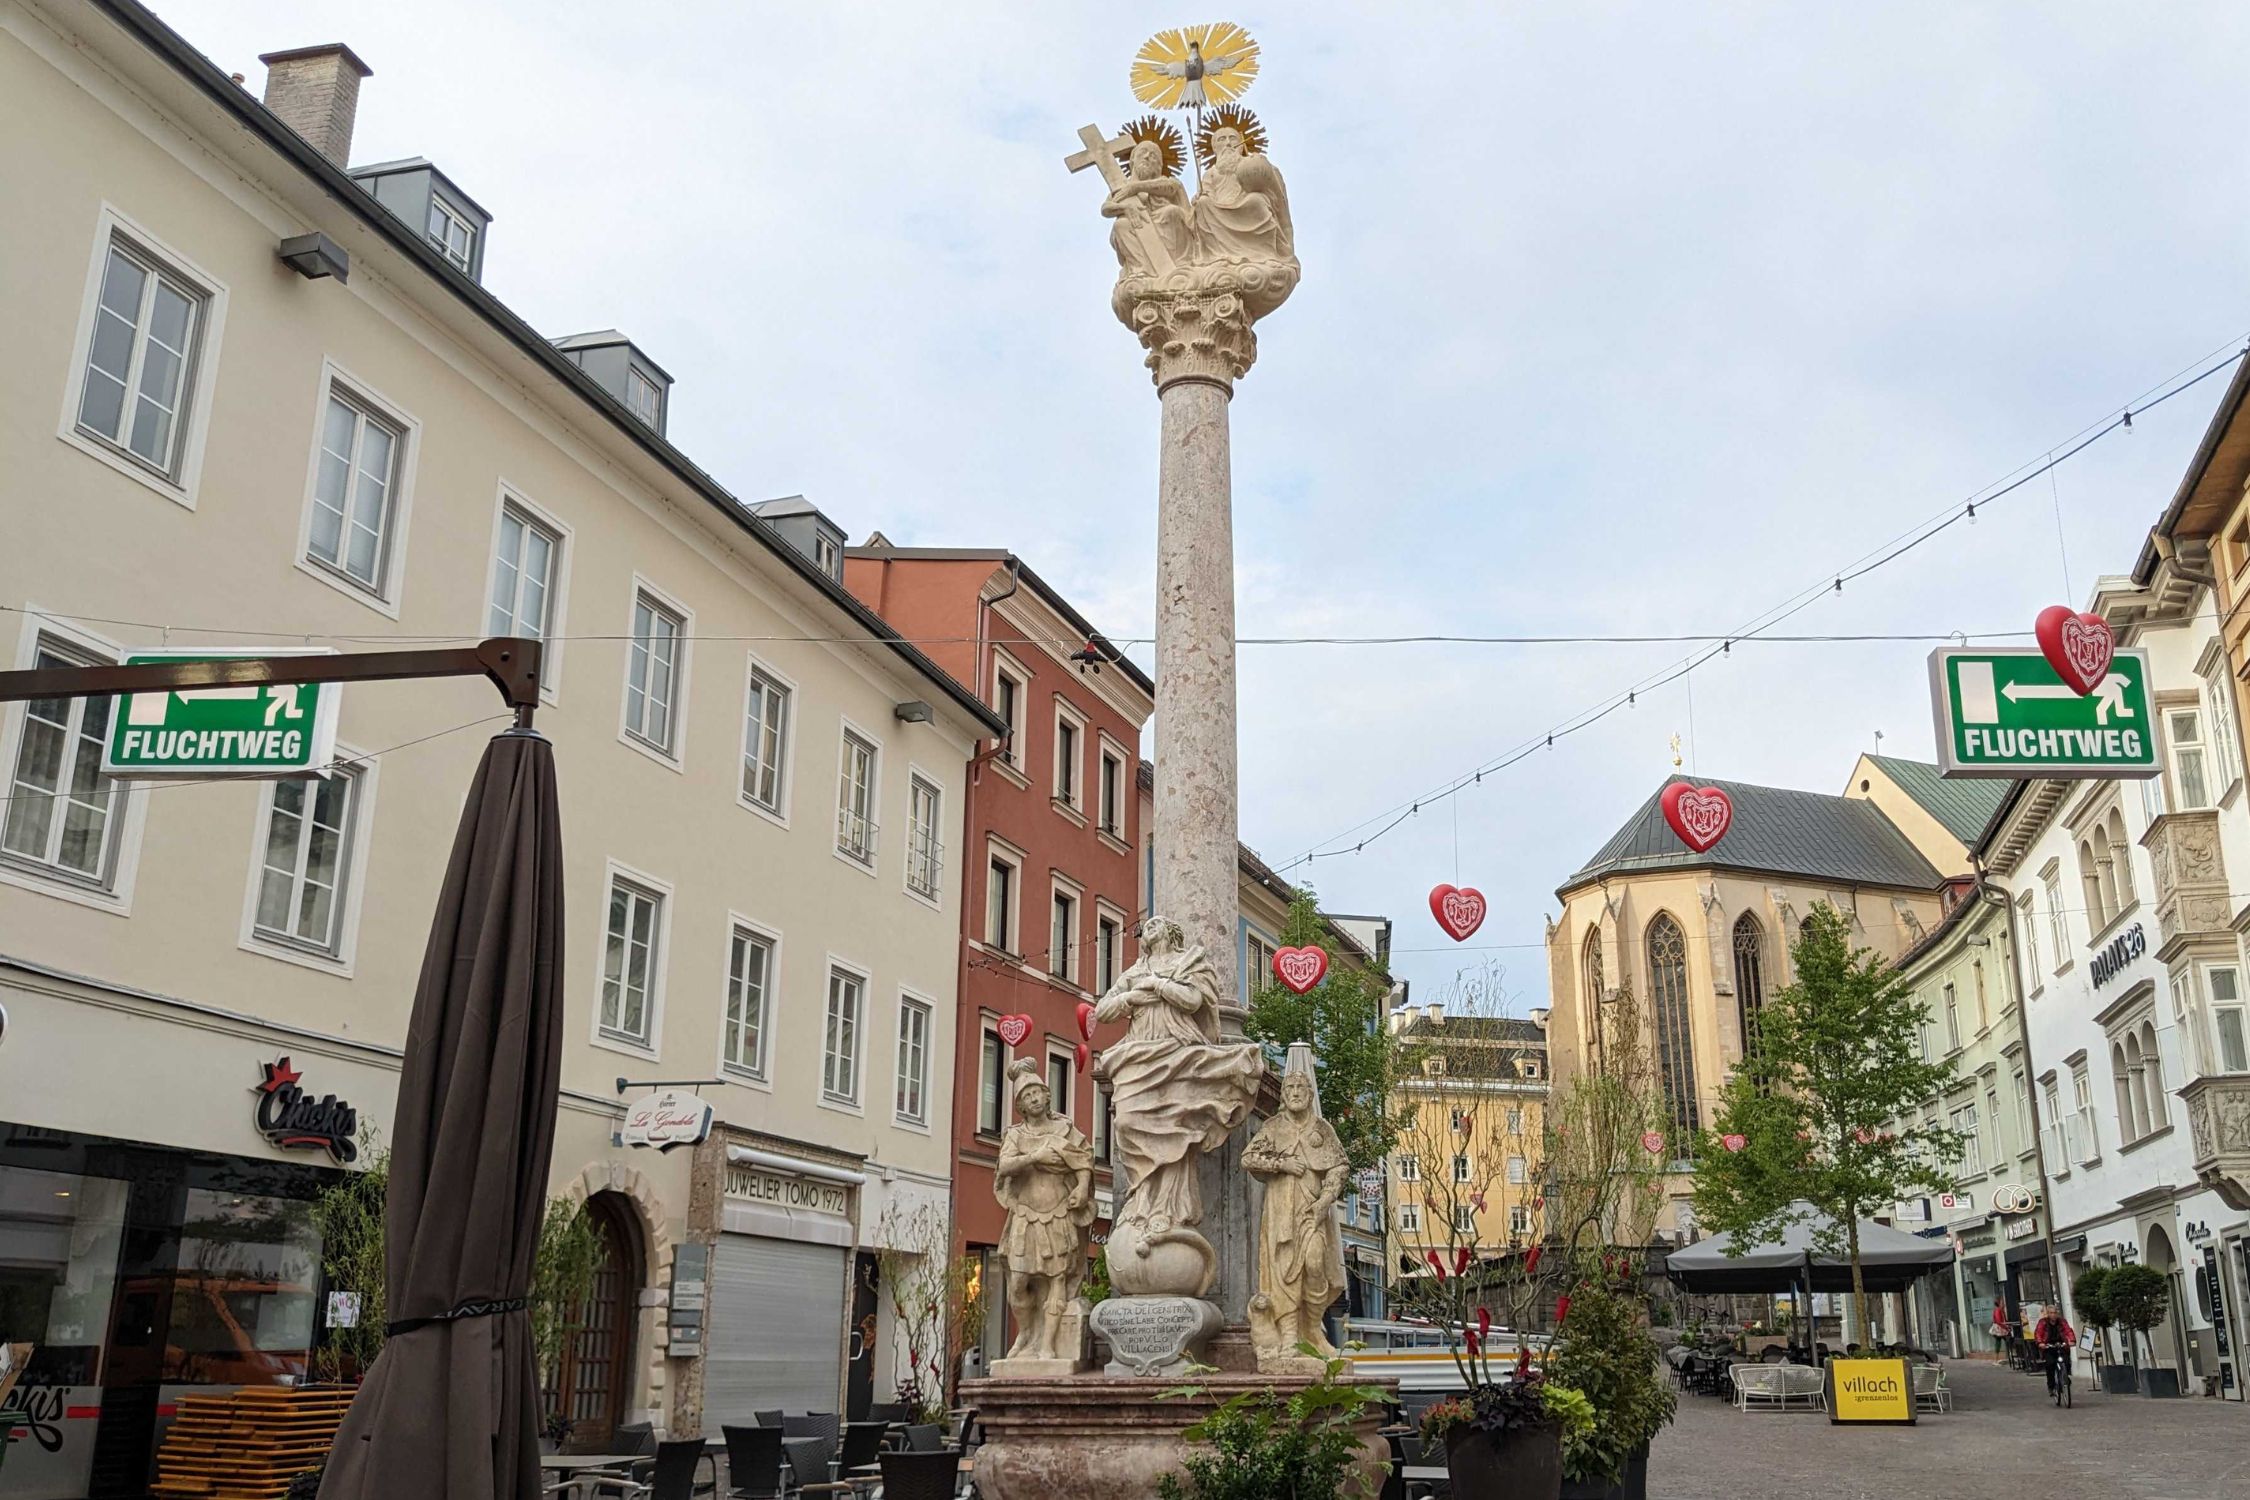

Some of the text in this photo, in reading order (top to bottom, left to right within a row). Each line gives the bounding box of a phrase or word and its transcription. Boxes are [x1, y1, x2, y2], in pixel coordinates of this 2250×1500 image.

[122, 729, 302, 760] FLUCHTWEG
[1964, 728, 2143, 758] FLUCHTWEG
[630, 1111, 698, 1131] La Gondola
[725, 1170, 844, 1212] JUWELIER TOMO 1972
[1843, 1376, 1898, 1393] villach
